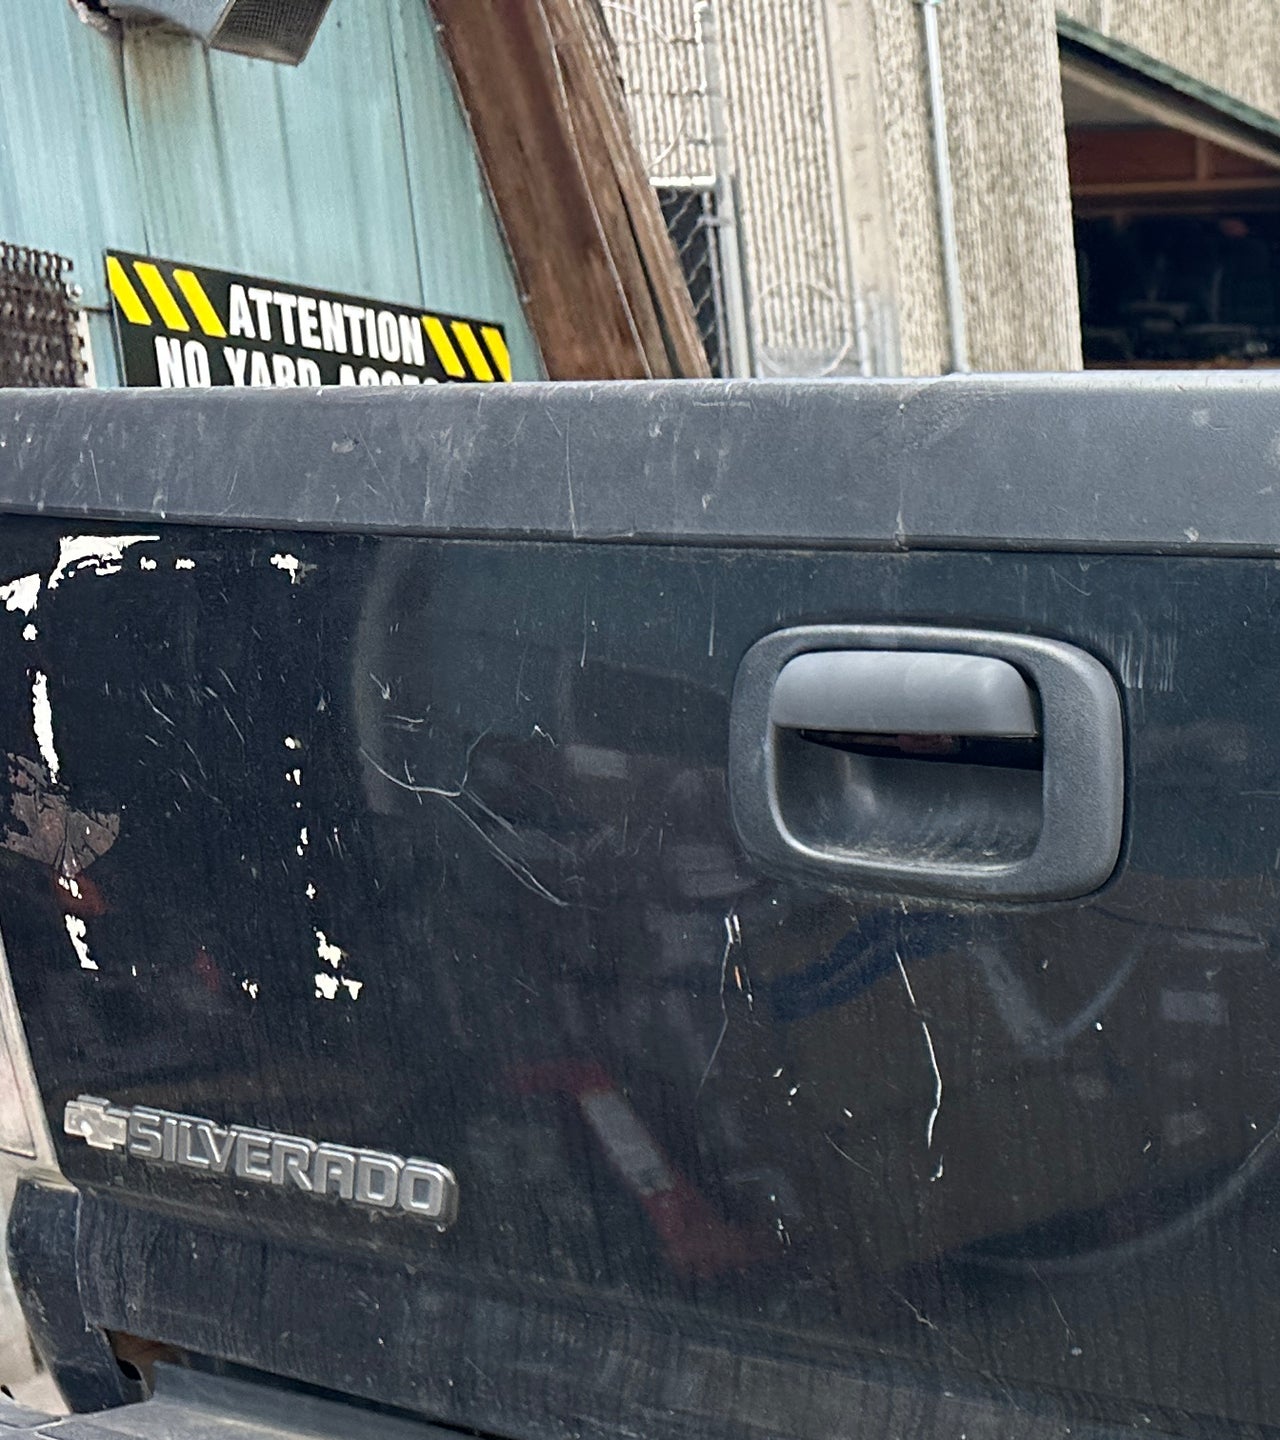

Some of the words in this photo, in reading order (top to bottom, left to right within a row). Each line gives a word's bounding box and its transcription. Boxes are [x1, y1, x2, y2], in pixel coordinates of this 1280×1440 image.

[154, 335, 212, 388] NO
[229, 283, 426, 367] ATTENTION
[128, 1105, 457, 1219] SILVERADO
